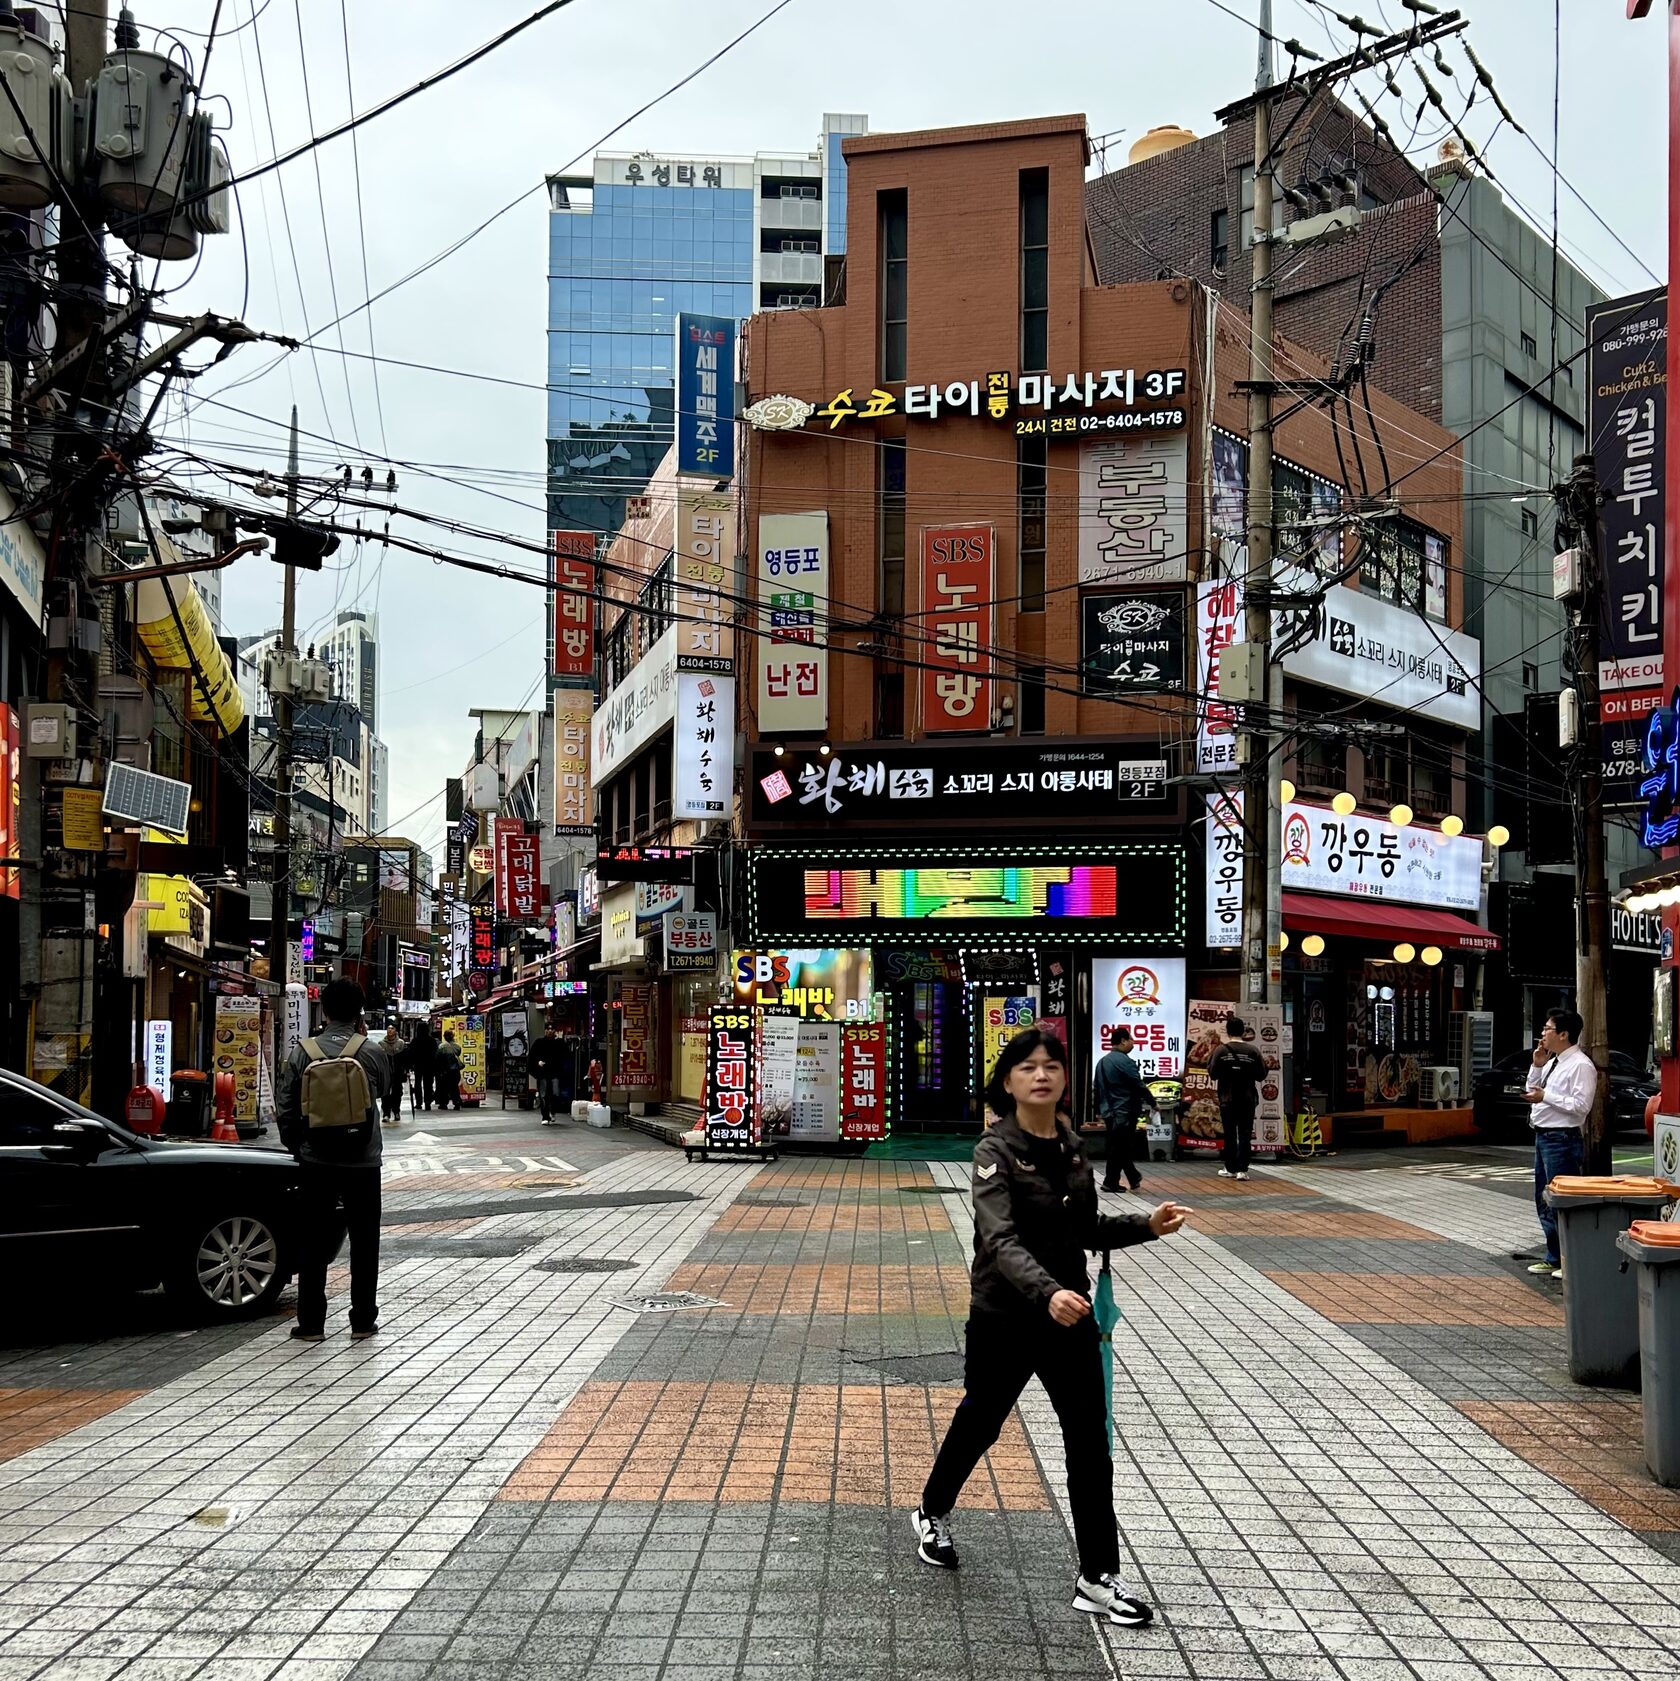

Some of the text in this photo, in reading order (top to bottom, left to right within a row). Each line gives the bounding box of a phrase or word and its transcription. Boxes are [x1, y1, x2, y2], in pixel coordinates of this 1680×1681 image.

[625, 163, 722, 188] 우성타워
[1620, 318, 1660, 336] 가맹문의
[1623, 360, 1656, 379] Cult 2
[905, 380, 979, 419] 타이
[988, 373, 1010, 418] 전통
[1018, 369, 1135, 410] 마사지
[1145, 371, 1183, 397] 3F
[1598, 374, 1643, 397] Chicken
[1642, 379, 1651, 389] &
[695, 345, 718, 447] 세계맥주
[1016, 410, 1183, 435] 24시 건전 02-6404-1578
[696, 448, 719, 463] 2F
[1097, 462, 1174, 563] 부동산
[1615, 398, 1658, 643] 컬투치킨
[691, 515, 724, 571] 타이
[765, 547, 820, 577] 영등포
[560, 536, 593, 658] SBS 노래방
[931, 534, 984, 717] SBS 노래방
[1121, 609, 1146, 624] SK
[1100, 643, 1124, 655] 타이
[1134, 640, 1170, 652] 마사지
[680, 656, 731, 671] 6404-1578
[1357, 636, 1385, 665] 소꼬리
[1388, 648, 1406, 672] 스지
[1409, 654, 1443, 685] 아롱사태
[766, 662, 818, 697] 난전
[1602, 665, 1640, 681] TAKE
[1450, 680, 1462, 693] 2F
[1604, 700, 1627, 714] ON
[562, 727, 587, 763] 타이
[1120, 765, 1166, 780] 영등포점
[893, 769, 930, 797] 수육
[943, 773, 993, 794] 소꼬리
[1001, 772, 1034, 792] 스지
[1041, 769, 1113, 792] 아롱사태
[1130, 781, 1157, 797] 2F
[562, 775, 587, 824] 마사지
[709, 801, 721, 811] 2F
[557, 826, 592, 835] 6404-1578
[1321, 822, 1401, 878] 깡우동
[511, 837, 536, 915] 고대닭발
[687, 918, 710, 930] 골드
[474, 918, 492, 965] 노래방
[670, 932, 713, 949] 부동산
[670, 955, 714, 967] T.2671-8940
[738, 956, 791, 984] SBS
[845, 1000, 868, 1018] B1
[988, 1008, 1033, 1026] SBS
[1122, 1006, 1157, 1017] 깡우동
[457, 1021, 483, 1032] SBS
[713, 1015, 750, 1029] SBS
[624, 1004, 648, 1073] 부동산
[847, 1029, 880, 1042] SBS
[462, 1035, 478, 1085] 노래방
[1157, 1057, 1179, 1077] 콜!
[614, 1074, 655, 1086] 2671-8940-1
[717, 1032, 748, 1110] 노래방
[851, 1045, 877, 1108] 노래방
[1185, 1074, 1218, 1091] 깡탕세
[711, 1128, 749, 1140] 신장개업
[847, 1123, 880, 1133] 신장개업
